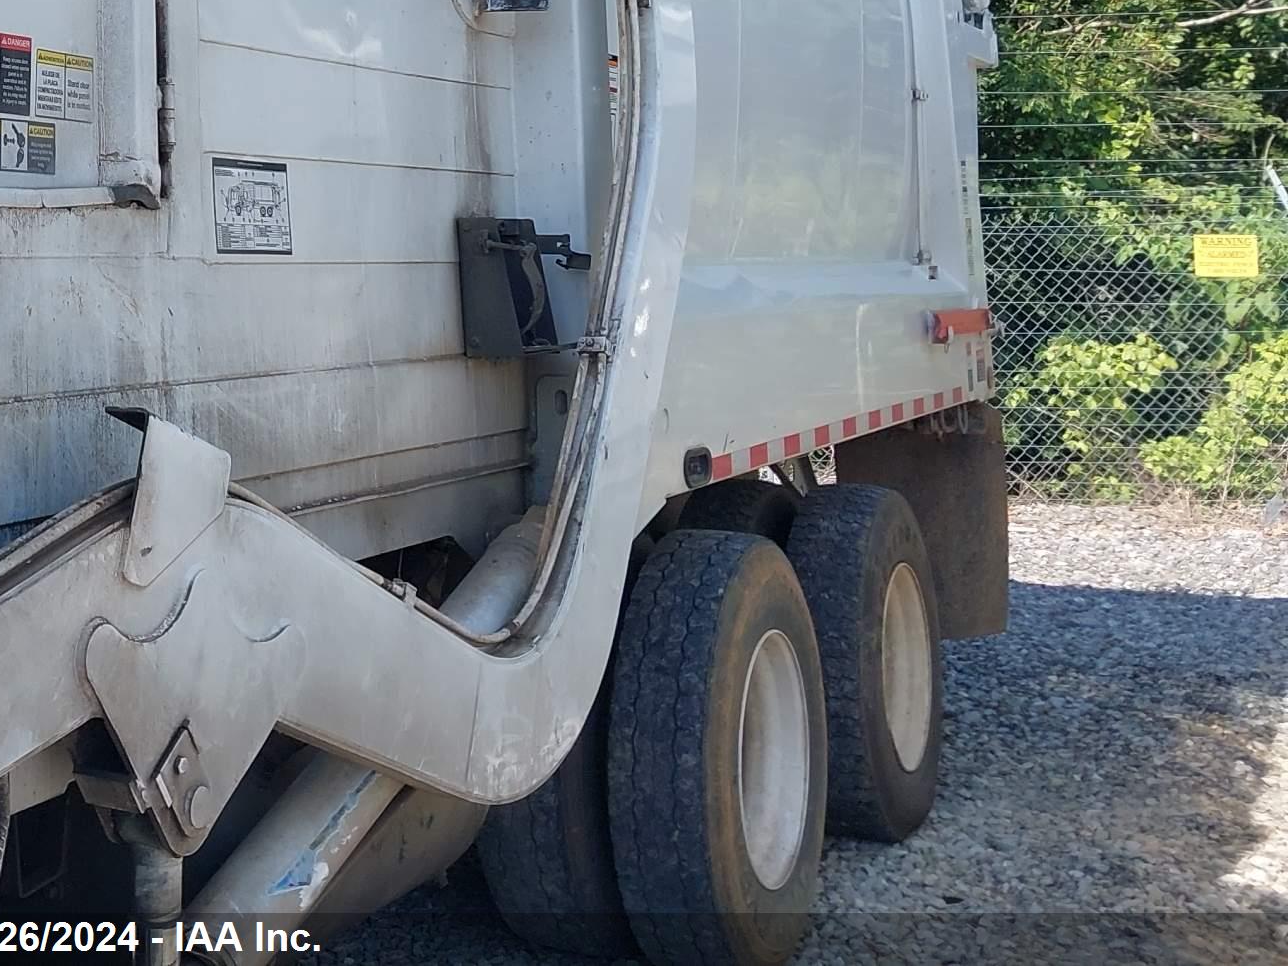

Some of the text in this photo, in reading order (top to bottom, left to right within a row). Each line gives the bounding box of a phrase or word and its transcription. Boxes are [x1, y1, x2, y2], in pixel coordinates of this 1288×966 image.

[8, 38, 30, 47] DANGER
[72, 59, 93, 67] CAUTION
[1200, 238, 1252, 246] WARNING
